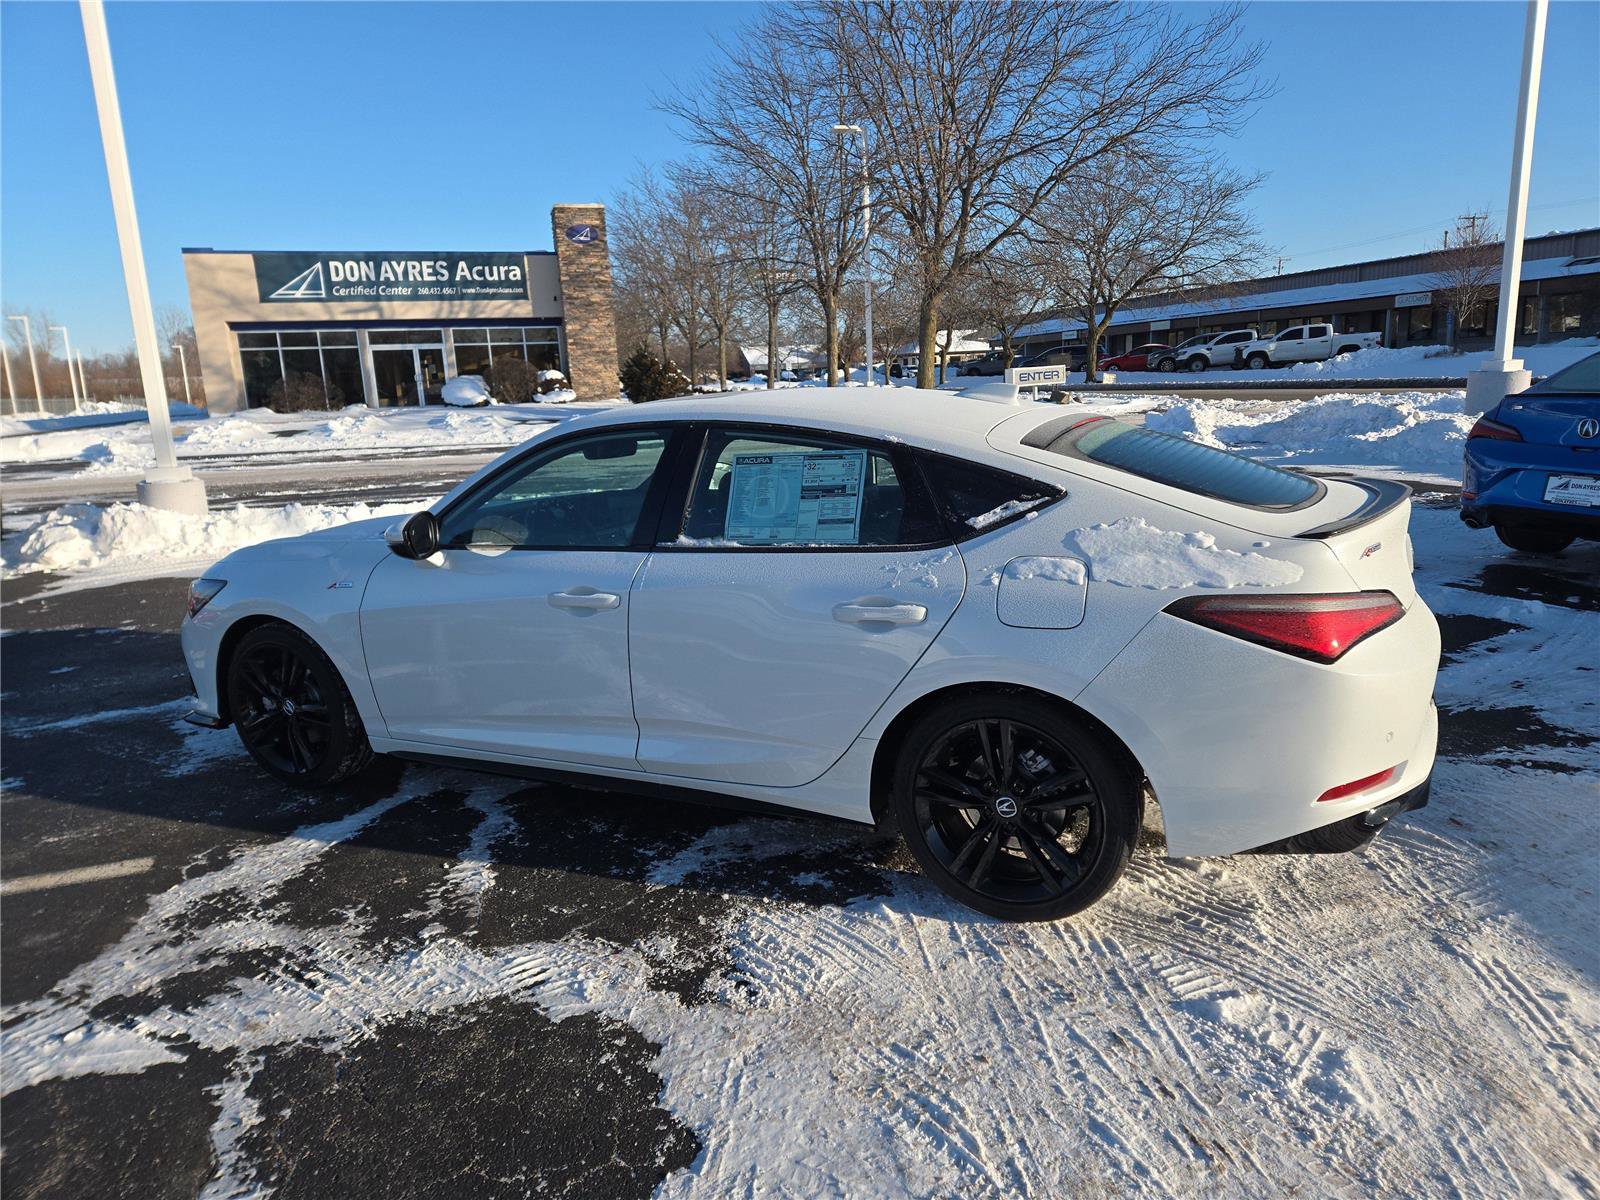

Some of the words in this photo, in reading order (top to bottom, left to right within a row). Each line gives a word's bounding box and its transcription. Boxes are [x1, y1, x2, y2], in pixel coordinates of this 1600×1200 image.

[328, 260, 376, 282] DON
[379, 260, 449, 282] AYRES
[455, 260, 522, 282] Acura
[332, 285, 377, 296] Certified
[378, 285, 412, 296] Center
[417, 287, 456, 295] 260.432.4567
[1019, 370, 1060, 382] ENTER
[807, 462, 817, 471] 32
